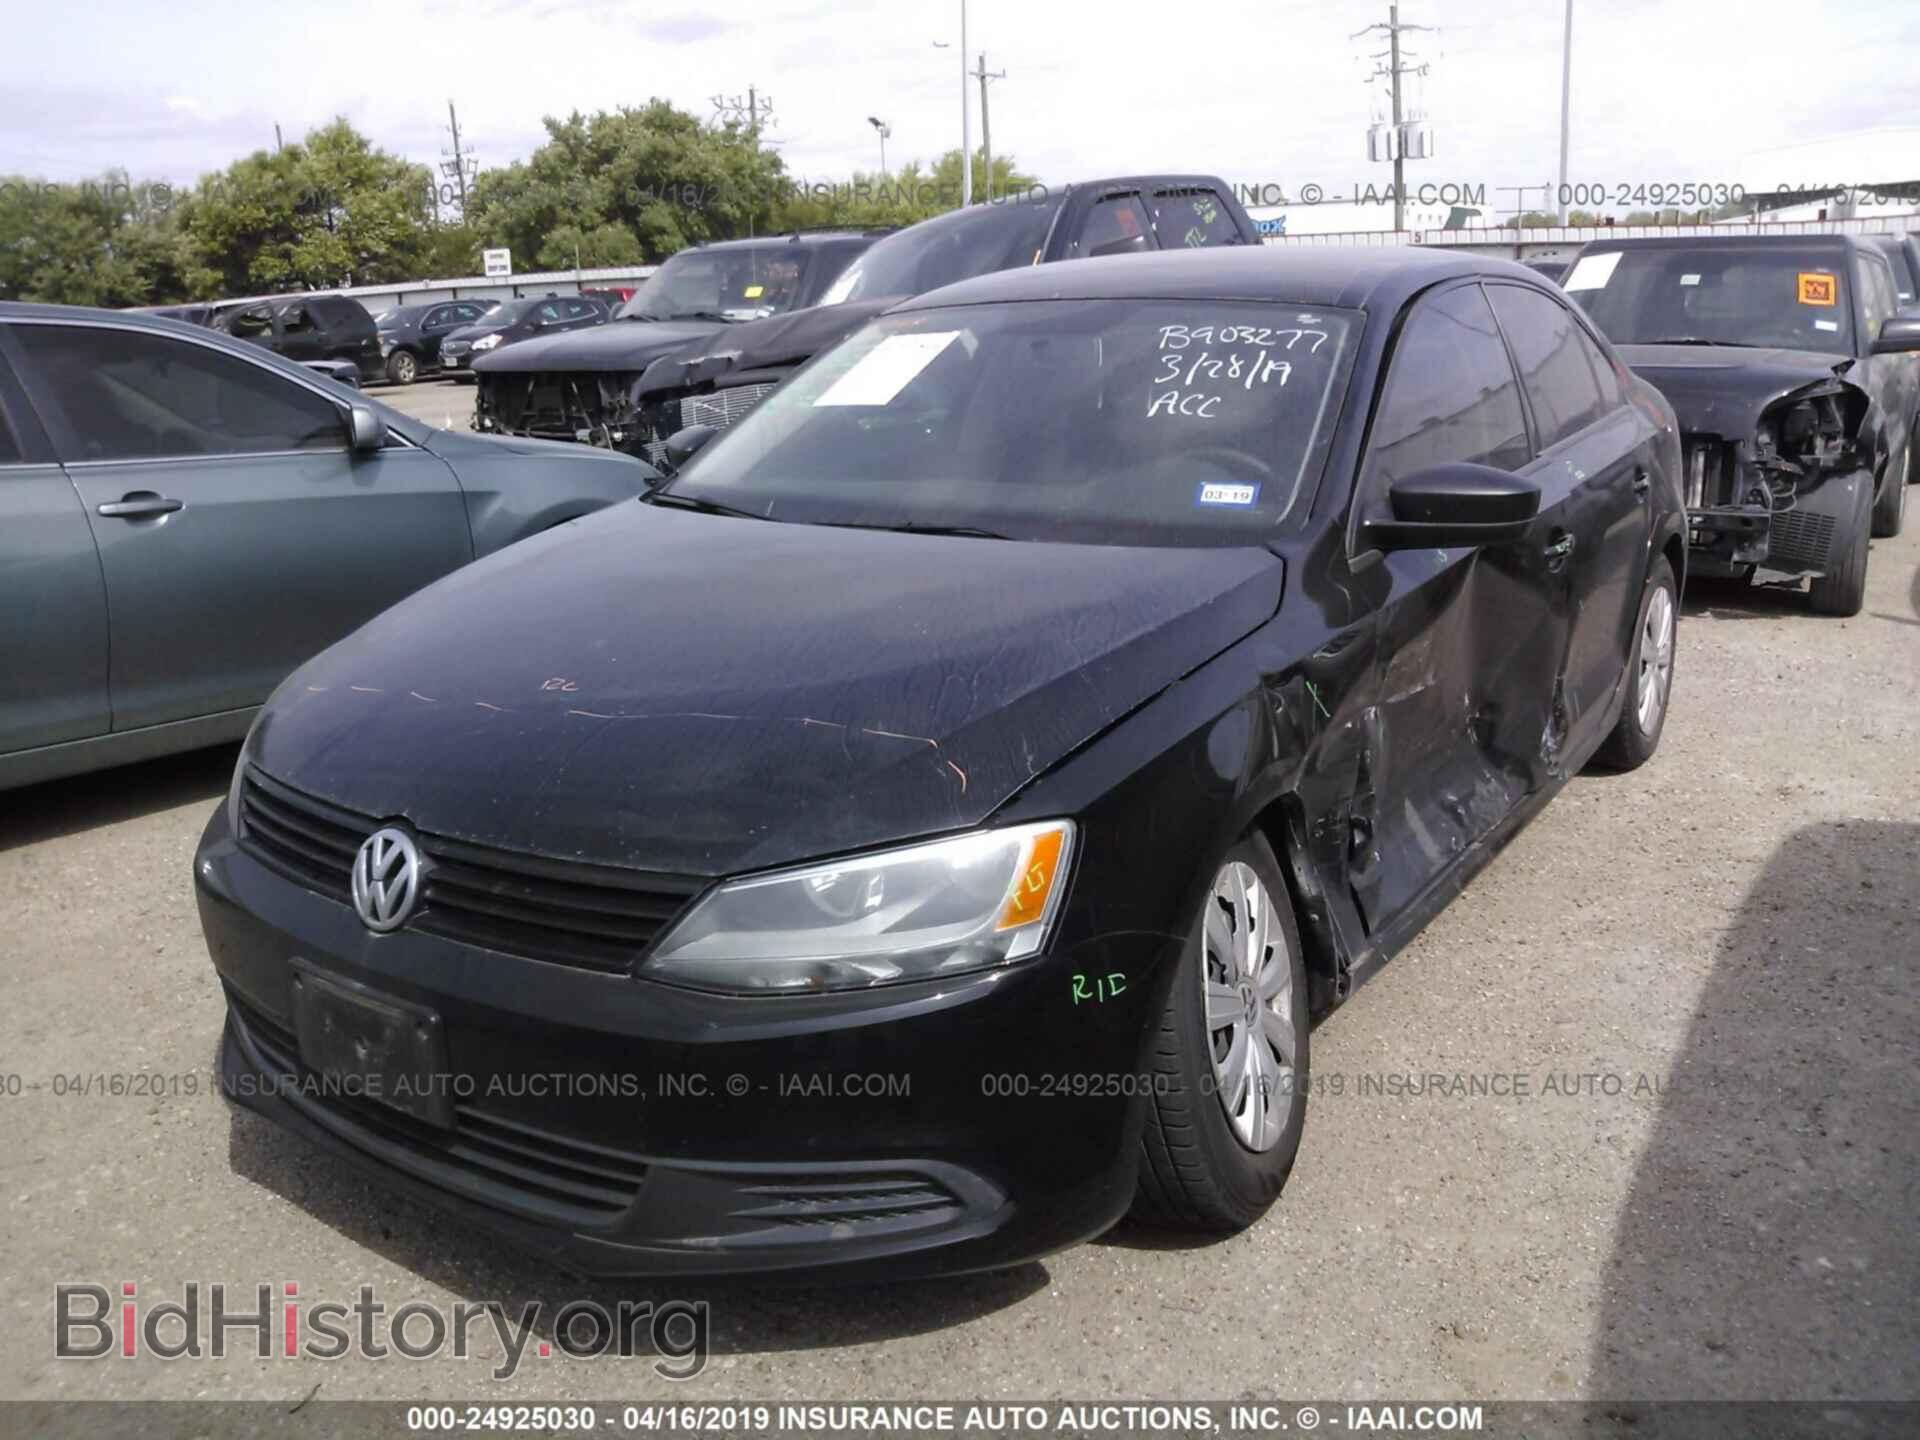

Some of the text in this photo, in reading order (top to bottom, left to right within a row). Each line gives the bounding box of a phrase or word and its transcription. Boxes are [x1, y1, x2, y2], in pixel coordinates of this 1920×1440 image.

[1159, 325, 1328, 352] B903277
[1154, 350, 1292, 389] 3/28/19
[1146, 391, 1221, 417] ACC
